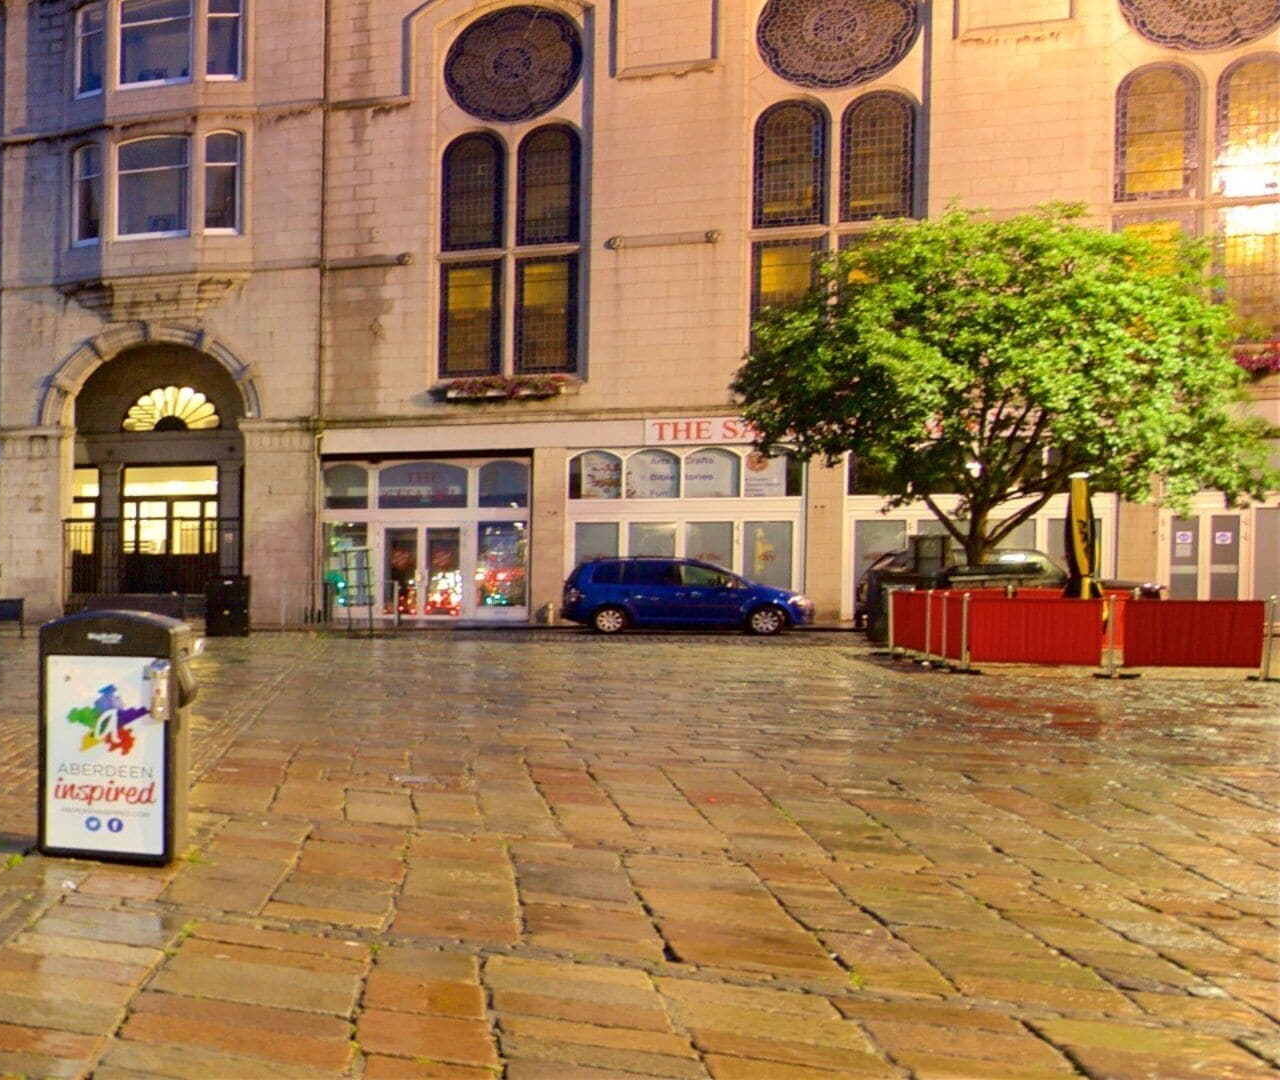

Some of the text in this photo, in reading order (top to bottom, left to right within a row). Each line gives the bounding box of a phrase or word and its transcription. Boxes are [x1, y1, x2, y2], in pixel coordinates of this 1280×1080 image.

[652, 420, 712, 441] THE
[56, 763, 154, 779] ABERDEEN
[54, 777, 156, 806] inspired
